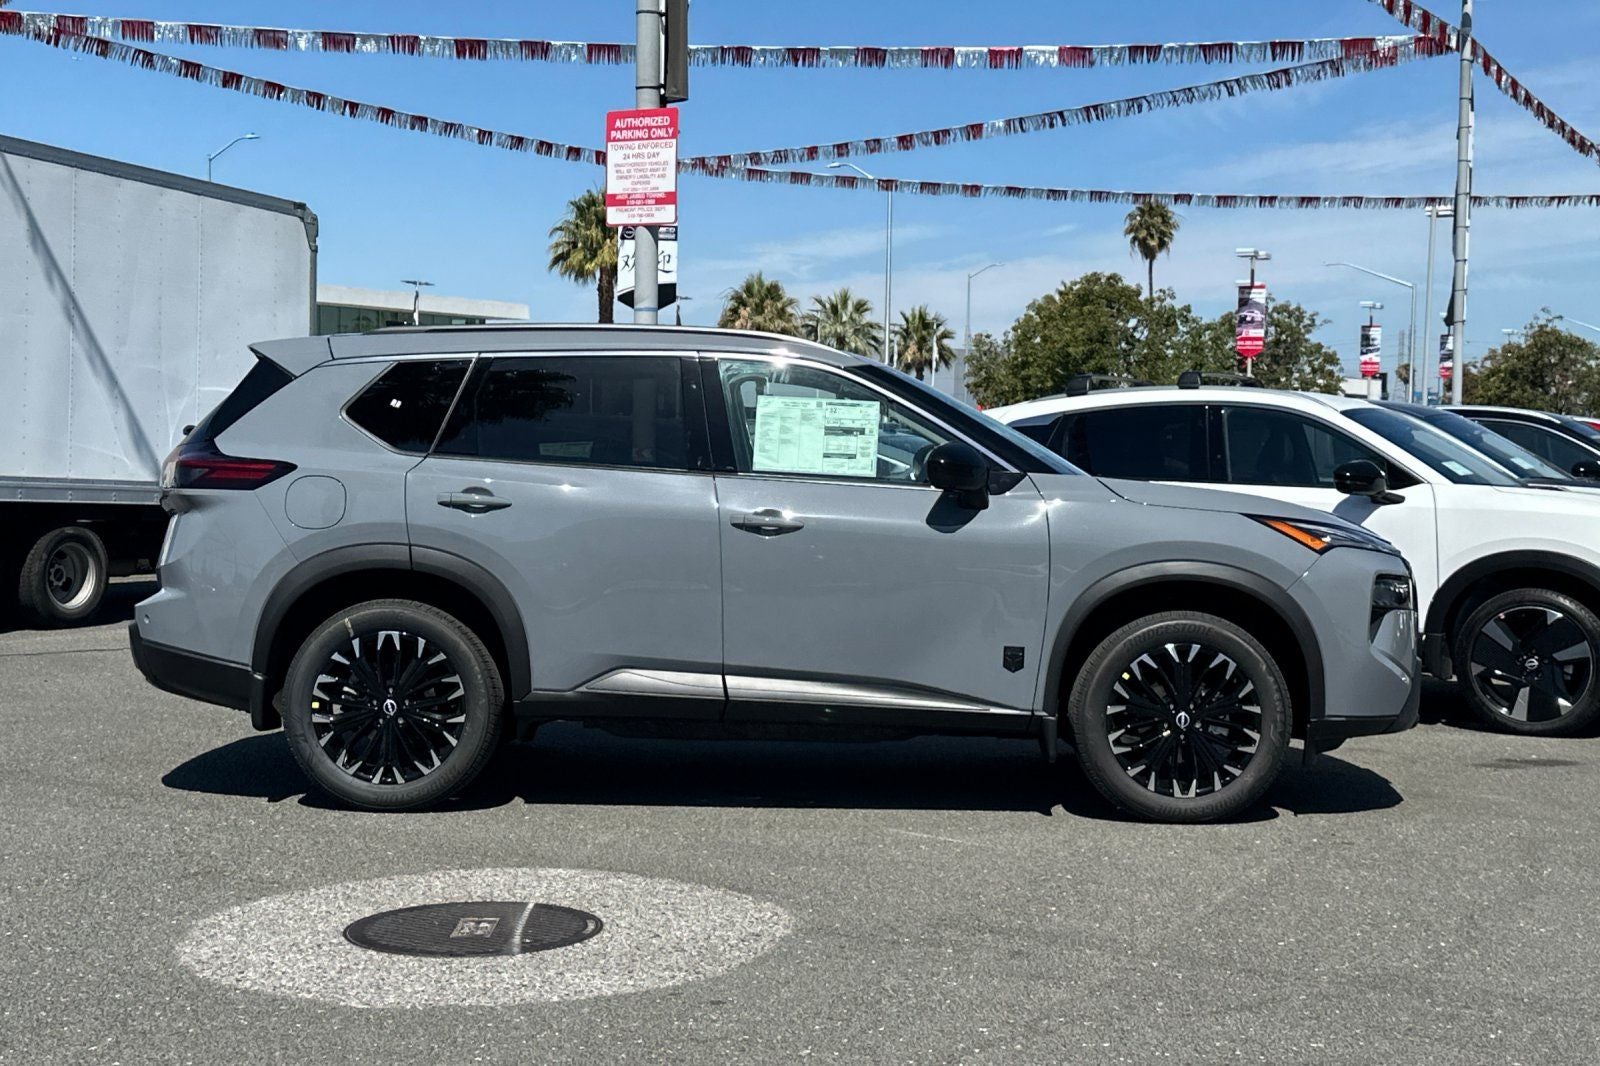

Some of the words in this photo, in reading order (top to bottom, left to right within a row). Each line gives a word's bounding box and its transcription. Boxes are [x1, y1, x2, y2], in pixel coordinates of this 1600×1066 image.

[614, 115, 671, 129] AUTHORIZED
[610, 129, 649, 140] PARKING
[650, 127, 674, 138] ONLY
[610, 143, 636, 151] TOWING
[638, 141, 674, 149] ENFORCED
[647, 151, 660, 159] DAY
[1124, 623, 1215, 650] BRIDGESTONE
